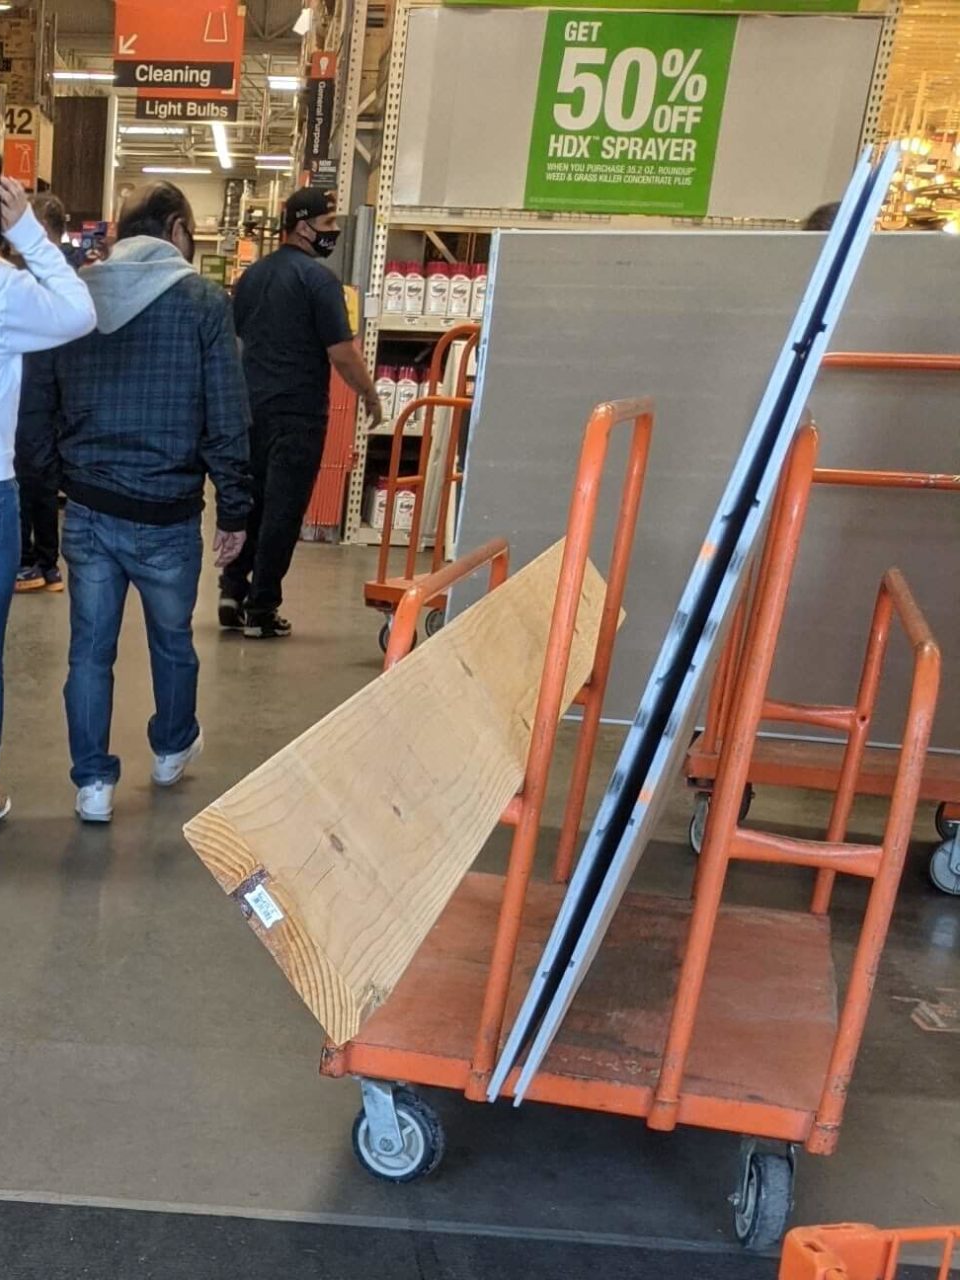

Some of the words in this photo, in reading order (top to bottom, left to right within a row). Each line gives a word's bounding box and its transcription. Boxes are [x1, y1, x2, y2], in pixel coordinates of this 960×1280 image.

[564, 21, 602, 42] GET
[135, 64, 211, 87] Cleaning
[316, 81, 327, 118] General
[553, 46, 708, 133] 50%
[5, 108, 33, 135] 42
[145, 100, 183, 119] Light
[186, 101, 228, 118] Bulbs
[652, 104, 704, 134] OFF
[313, 117, 323, 154] Purpose
[601, 136, 697, 162] SPRAYER
[546, 163, 569, 172] WHEN
[570, 163, 585, 172] YOU
[586, 164, 625, 174] PURCHASE
[546, 172, 566, 182] WEED
[574, 173, 598, 183] GRASS
[599, 174, 623, 183] KILLER
[623, 175, 672, 185] CONCENTRATE
